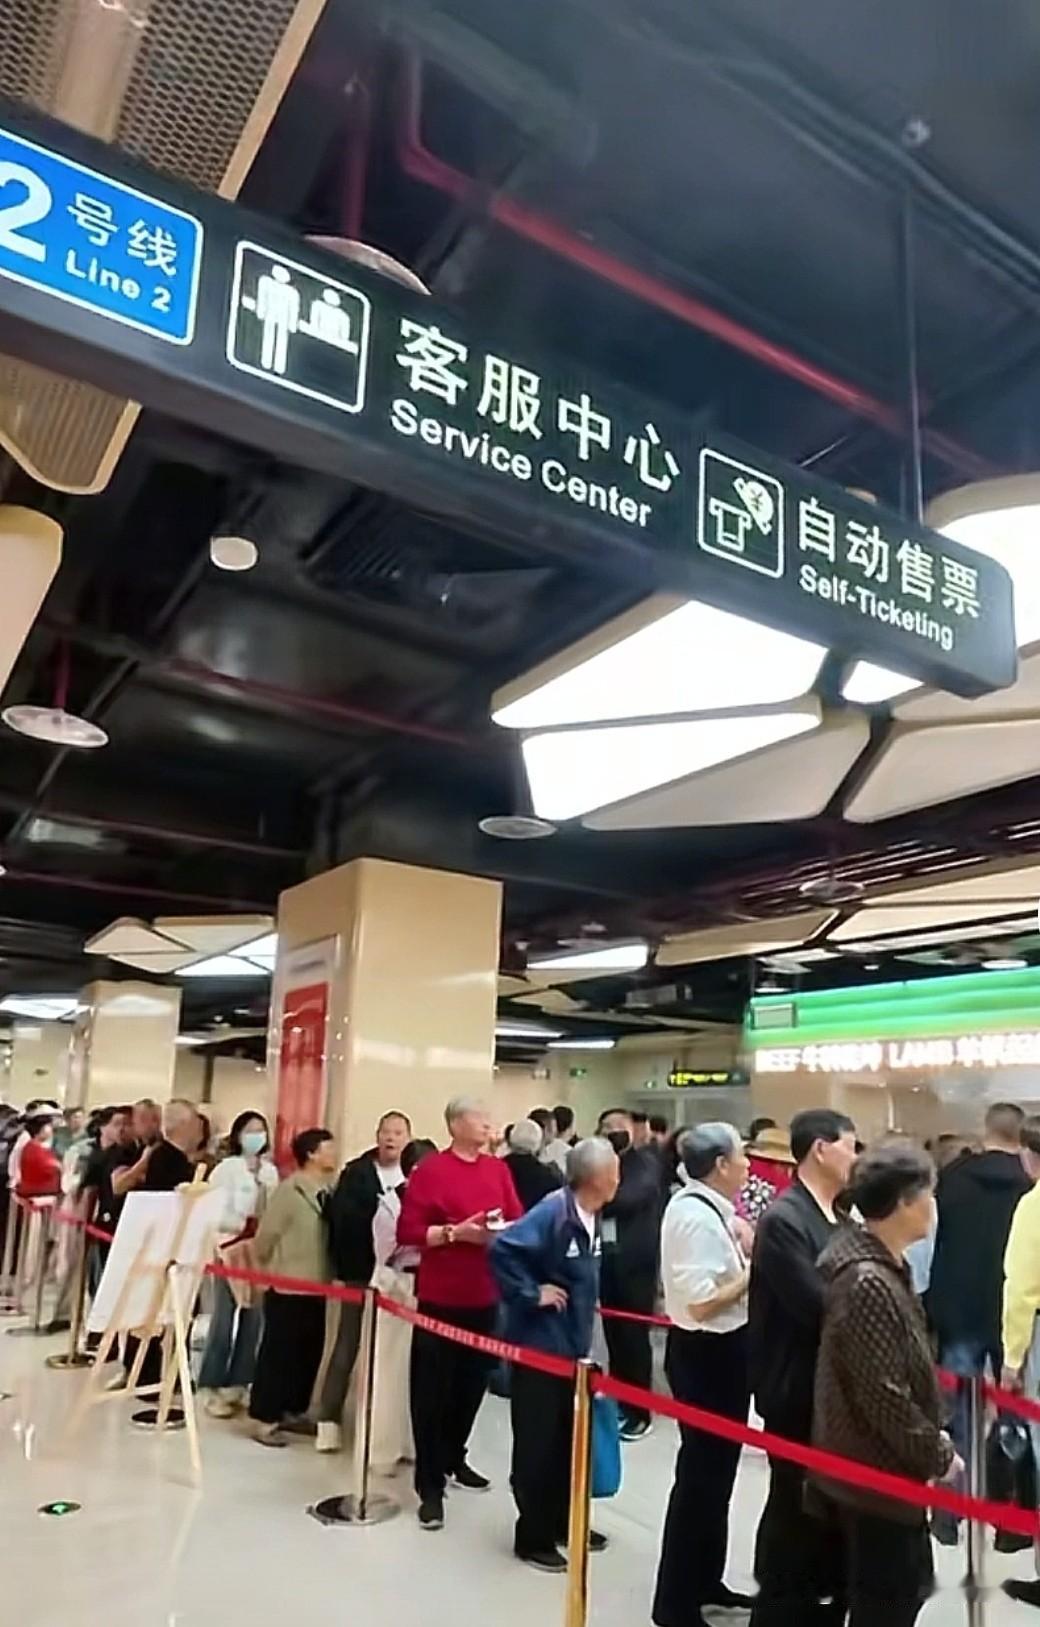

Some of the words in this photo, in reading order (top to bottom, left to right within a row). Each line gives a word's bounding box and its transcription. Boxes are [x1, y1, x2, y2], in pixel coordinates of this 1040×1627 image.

[65, 249, 141, 300] Line
[152, 286, 171, 314] 2
[390, 399, 532, 480] Service
[541, 459, 652, 527] Center
[396, 317, 681, 492] 客服中心
[799, 496, 981, 619] 自动售票
[799, 563, 954, 651] Self-Ticketing
